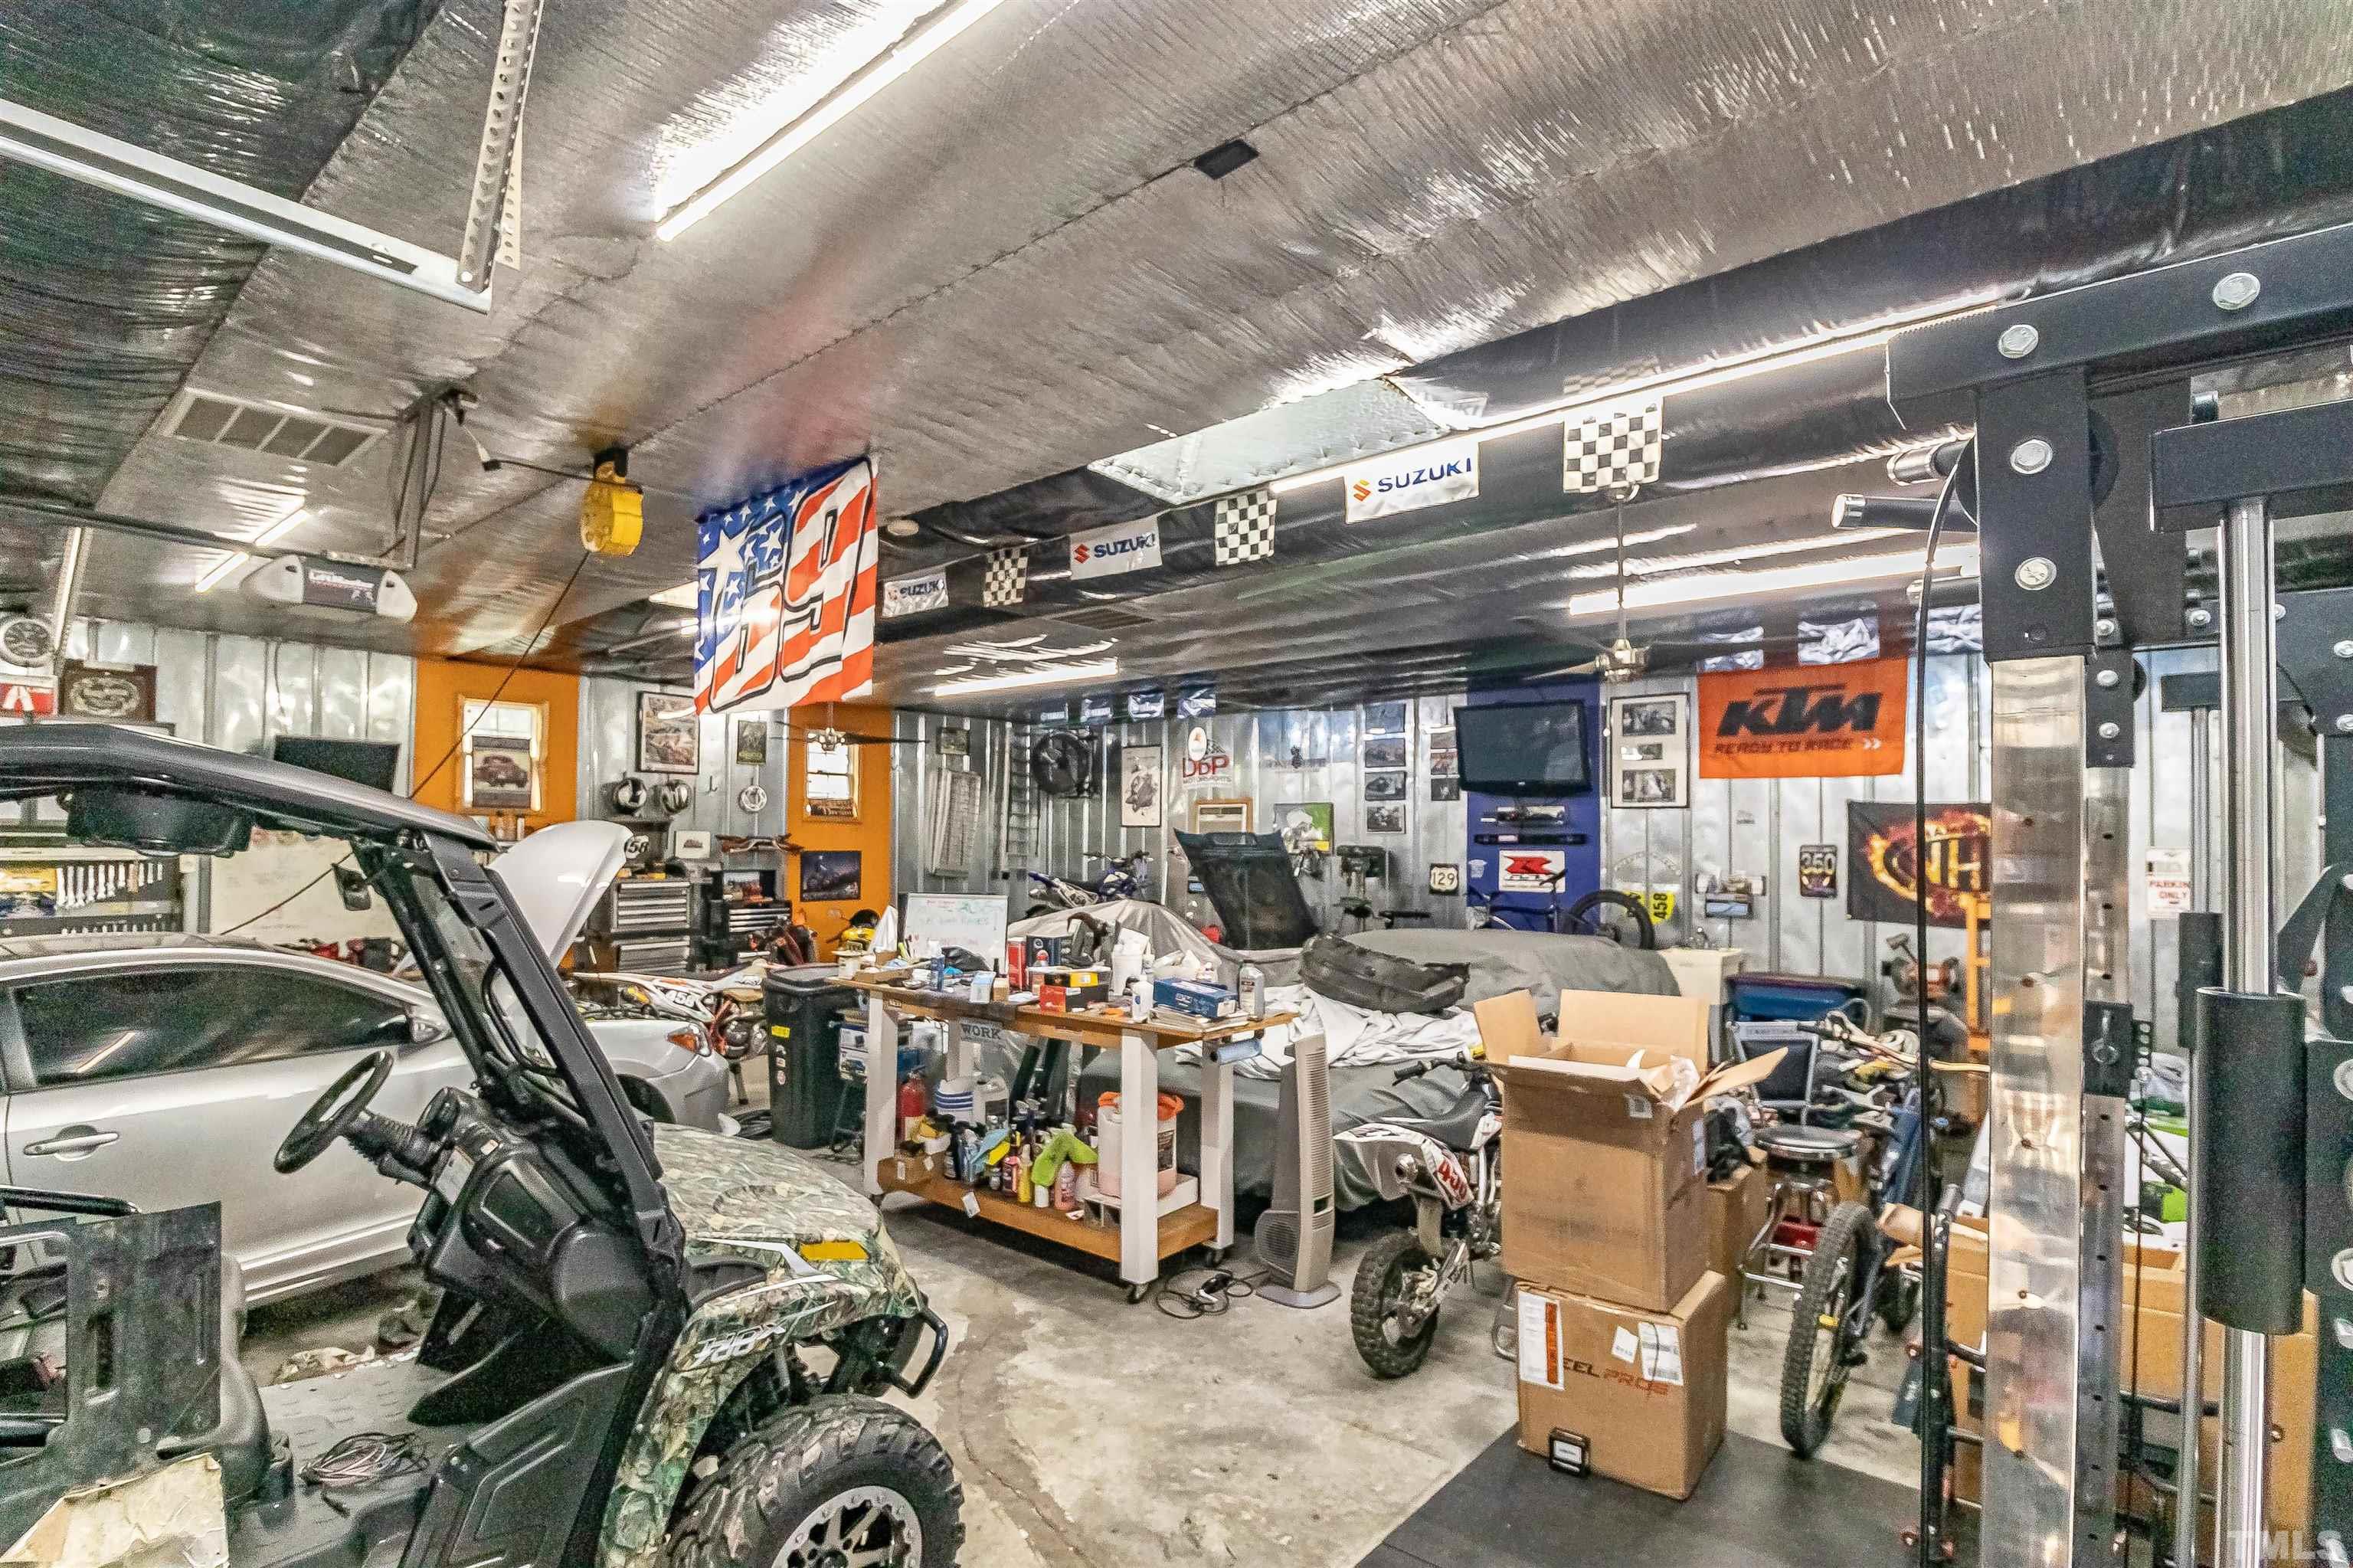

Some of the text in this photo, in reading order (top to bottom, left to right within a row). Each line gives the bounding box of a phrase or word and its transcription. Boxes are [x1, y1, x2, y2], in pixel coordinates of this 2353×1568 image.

[1378, 457, 1472, 493] SUZUKI
[1094, 532, 1155, 558] SUZUKI
[708, 460, 872, 714] 69
[1716, 683, 1883, 737] KTM
[1432, 871, 1455, 886] 129
[1652, 892, 1668, 919] 458
[961, 1023, 1000, 1040] WORK
